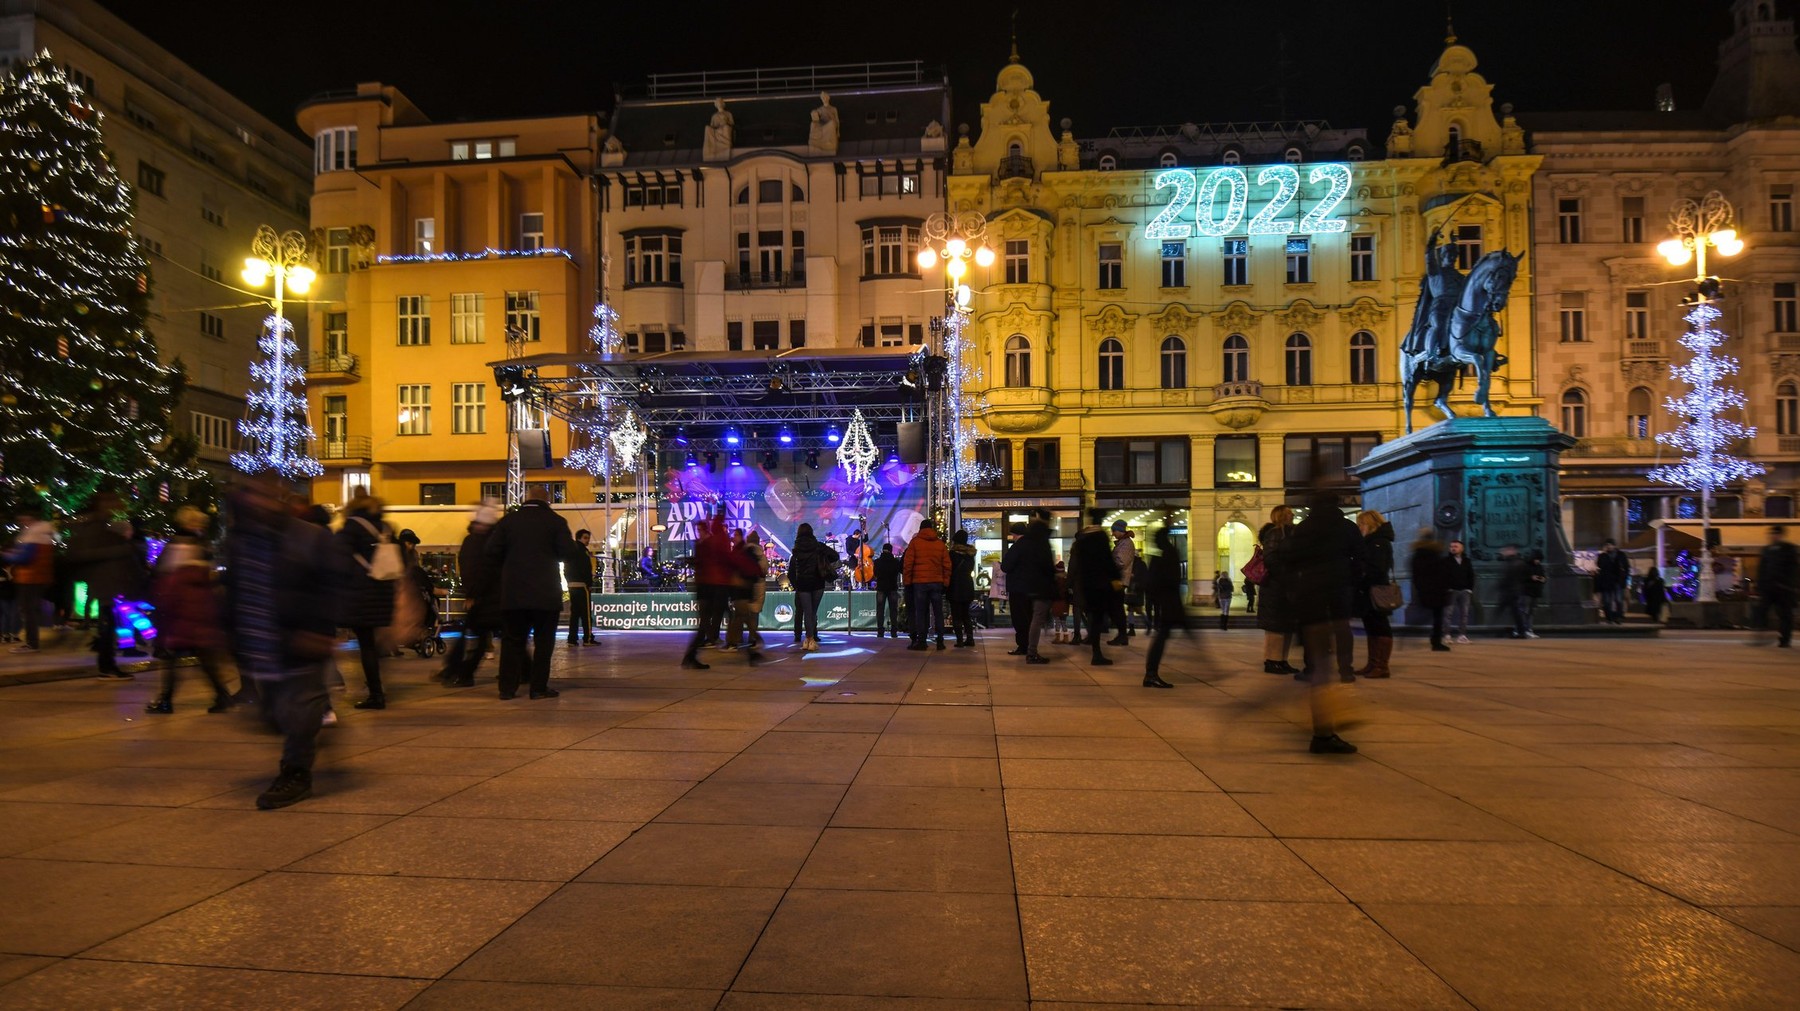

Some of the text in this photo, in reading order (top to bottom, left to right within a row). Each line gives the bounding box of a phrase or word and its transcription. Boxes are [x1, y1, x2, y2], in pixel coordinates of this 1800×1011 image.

[1144, 163, 1352, 239] 2022
[668, 519, 752, 541] ZAEB
[651, 601, 699, 612] hrvatsk
[596, 615, 682, 629] Etnografskom
